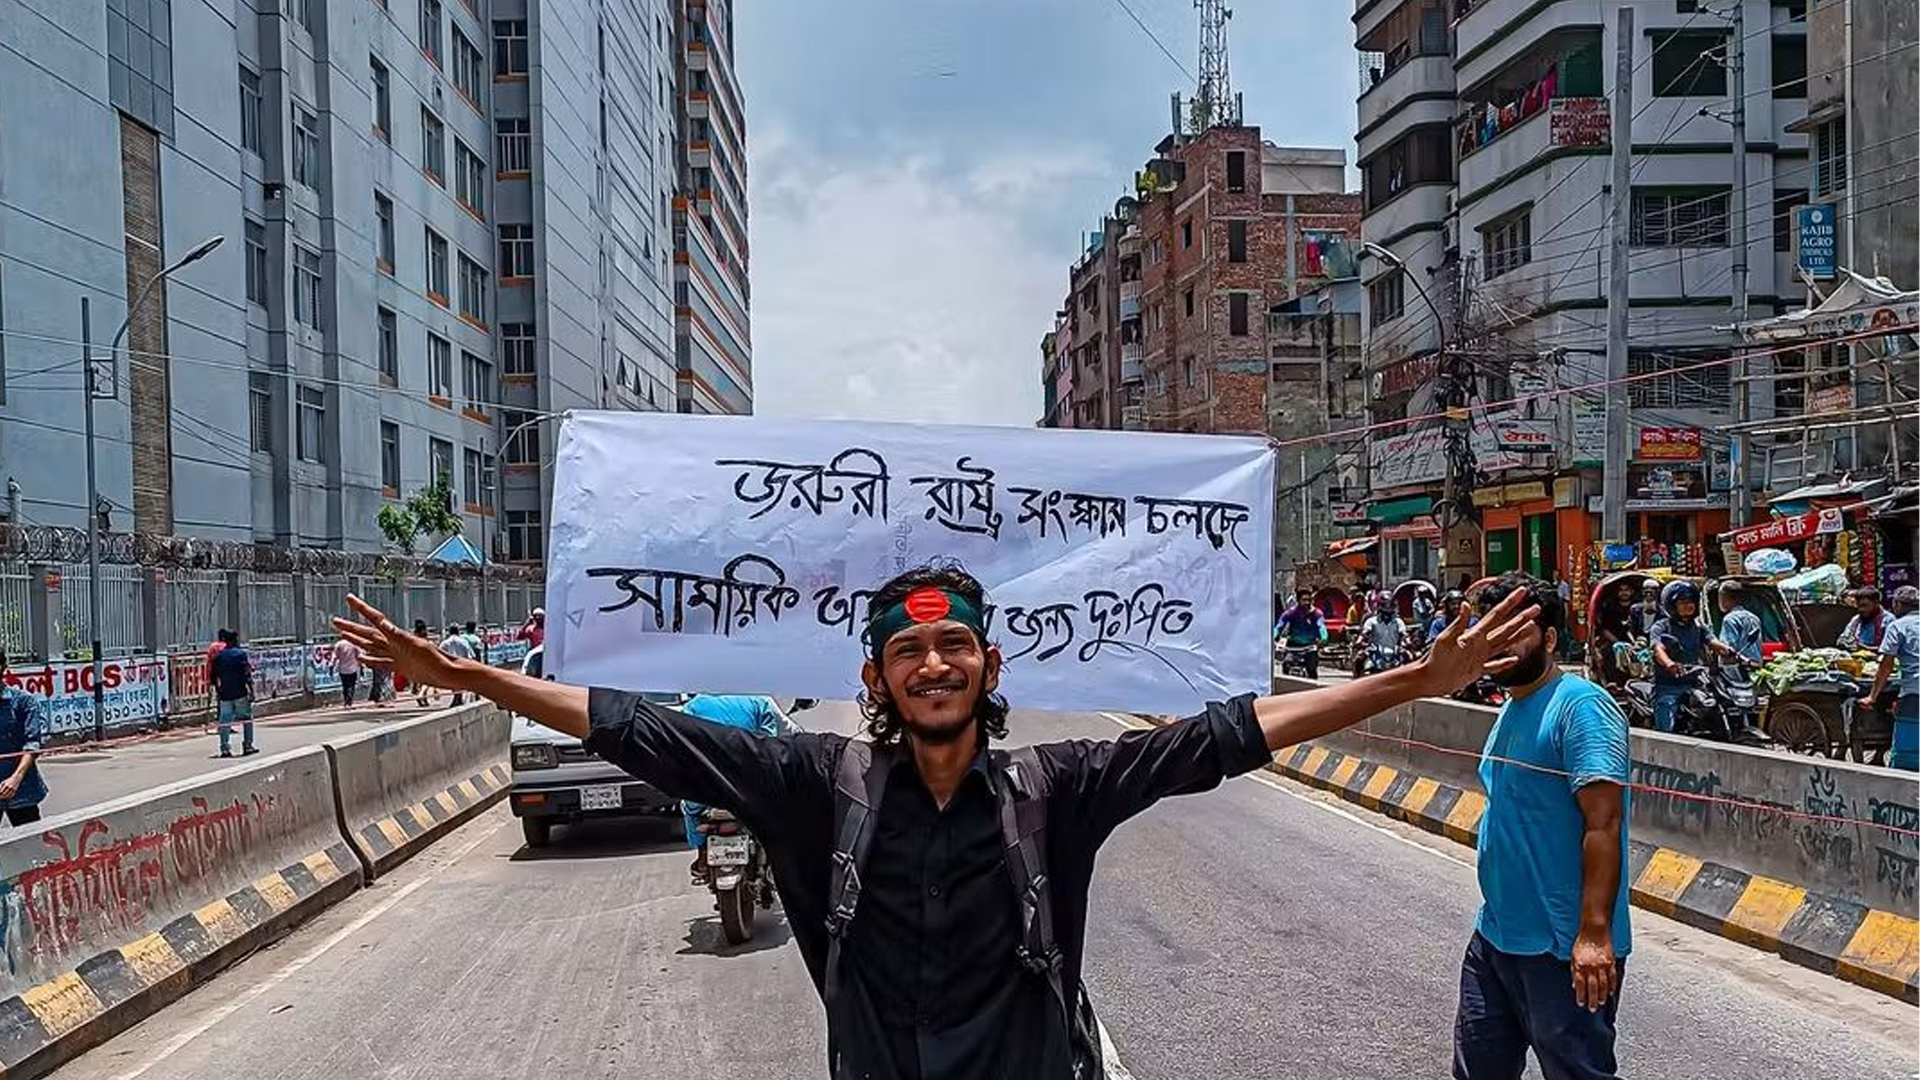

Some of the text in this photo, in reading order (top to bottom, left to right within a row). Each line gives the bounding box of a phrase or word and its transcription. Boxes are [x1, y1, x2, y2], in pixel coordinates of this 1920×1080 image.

[1802, 237, 1834, 247] AGRO
[715, 448, 1250, 560] জরুরী রাষ্ট্র সংস্কার চলছে
[1760, 522, 1784, 541] মানি
[586, 553, 799, 637] সাময়িক
[1005, 603, 1079, 662] জন্য
[64, 664, 122, 694] BCS
